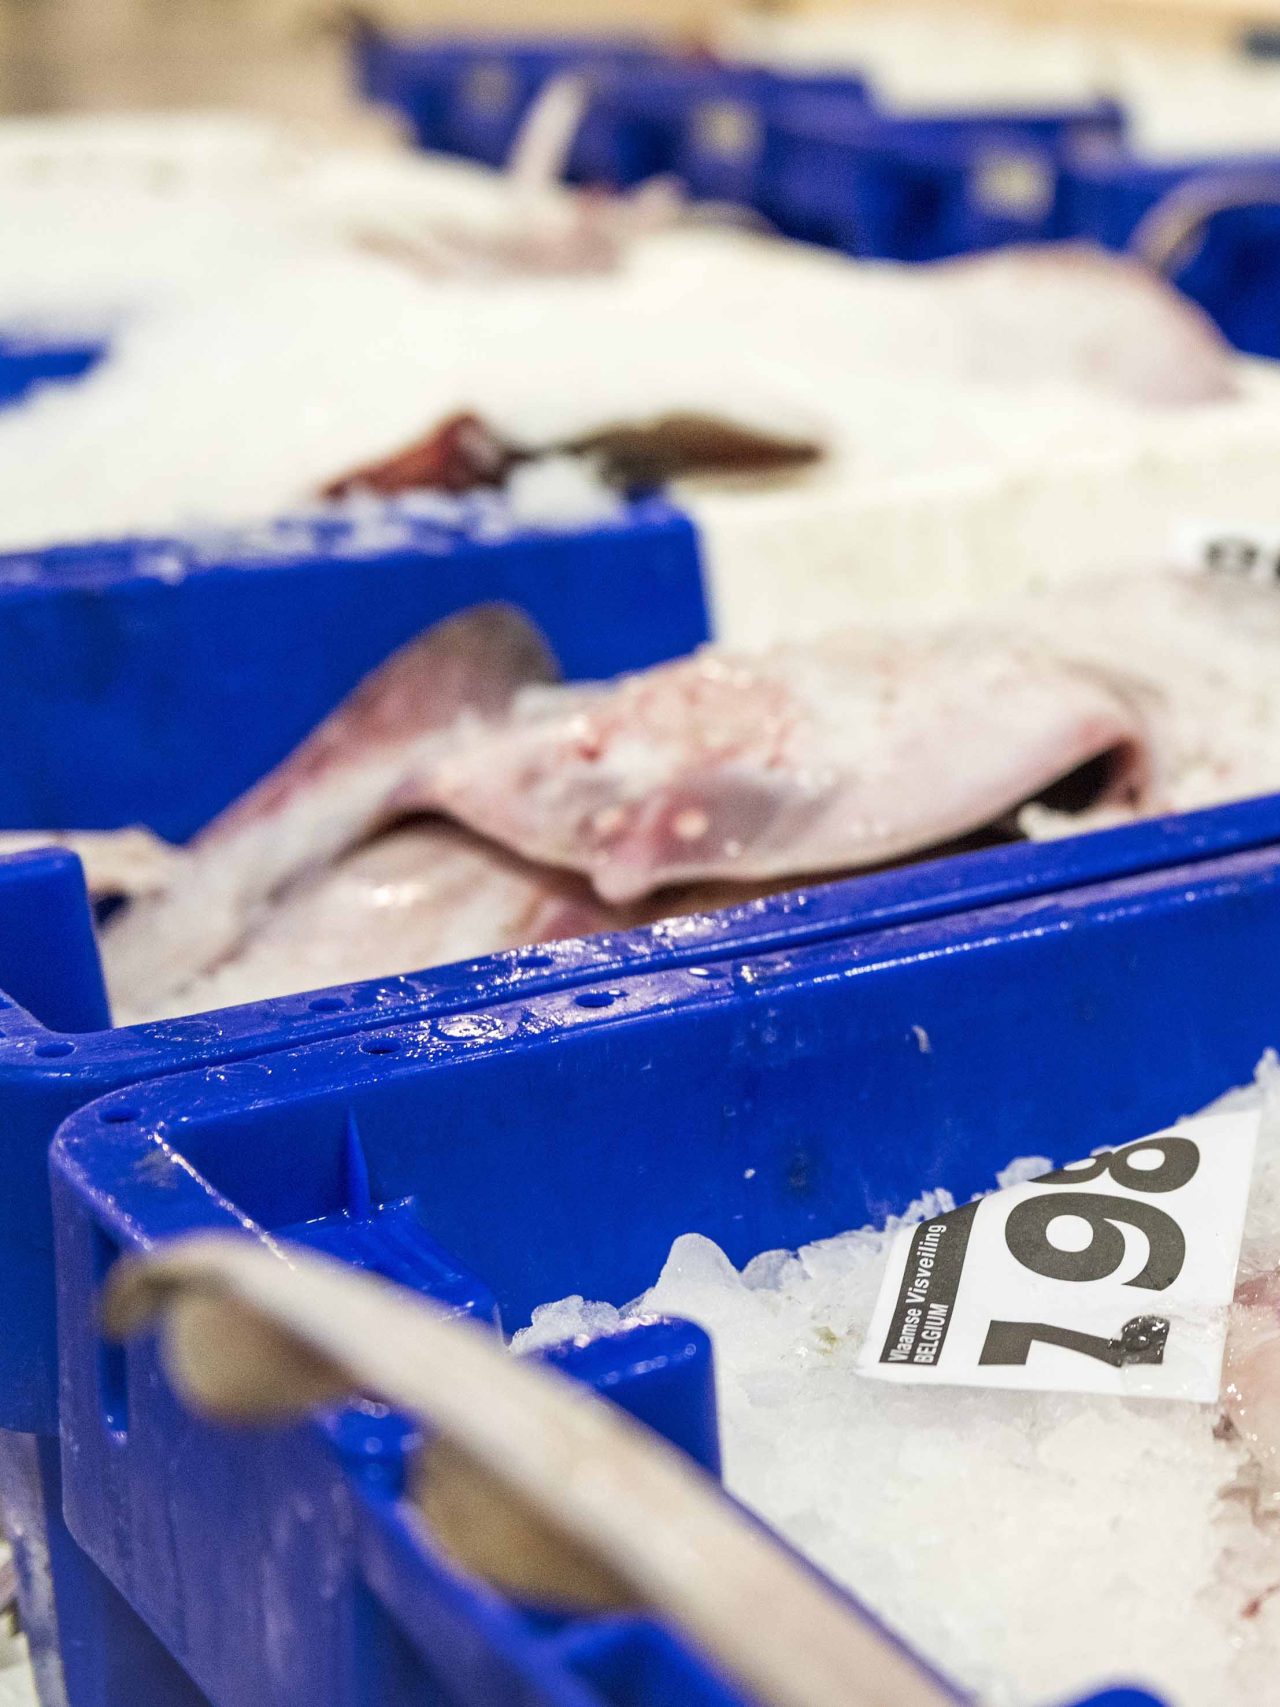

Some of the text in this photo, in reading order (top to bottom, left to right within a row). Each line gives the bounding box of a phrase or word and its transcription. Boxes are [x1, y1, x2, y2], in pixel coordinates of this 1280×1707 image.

[888, 1224, 947, 1363] Vlaamse Visveiling
[978, 1136, 1200, 1368] 798
[913, 1302, 949, 1364] BELGIUM
